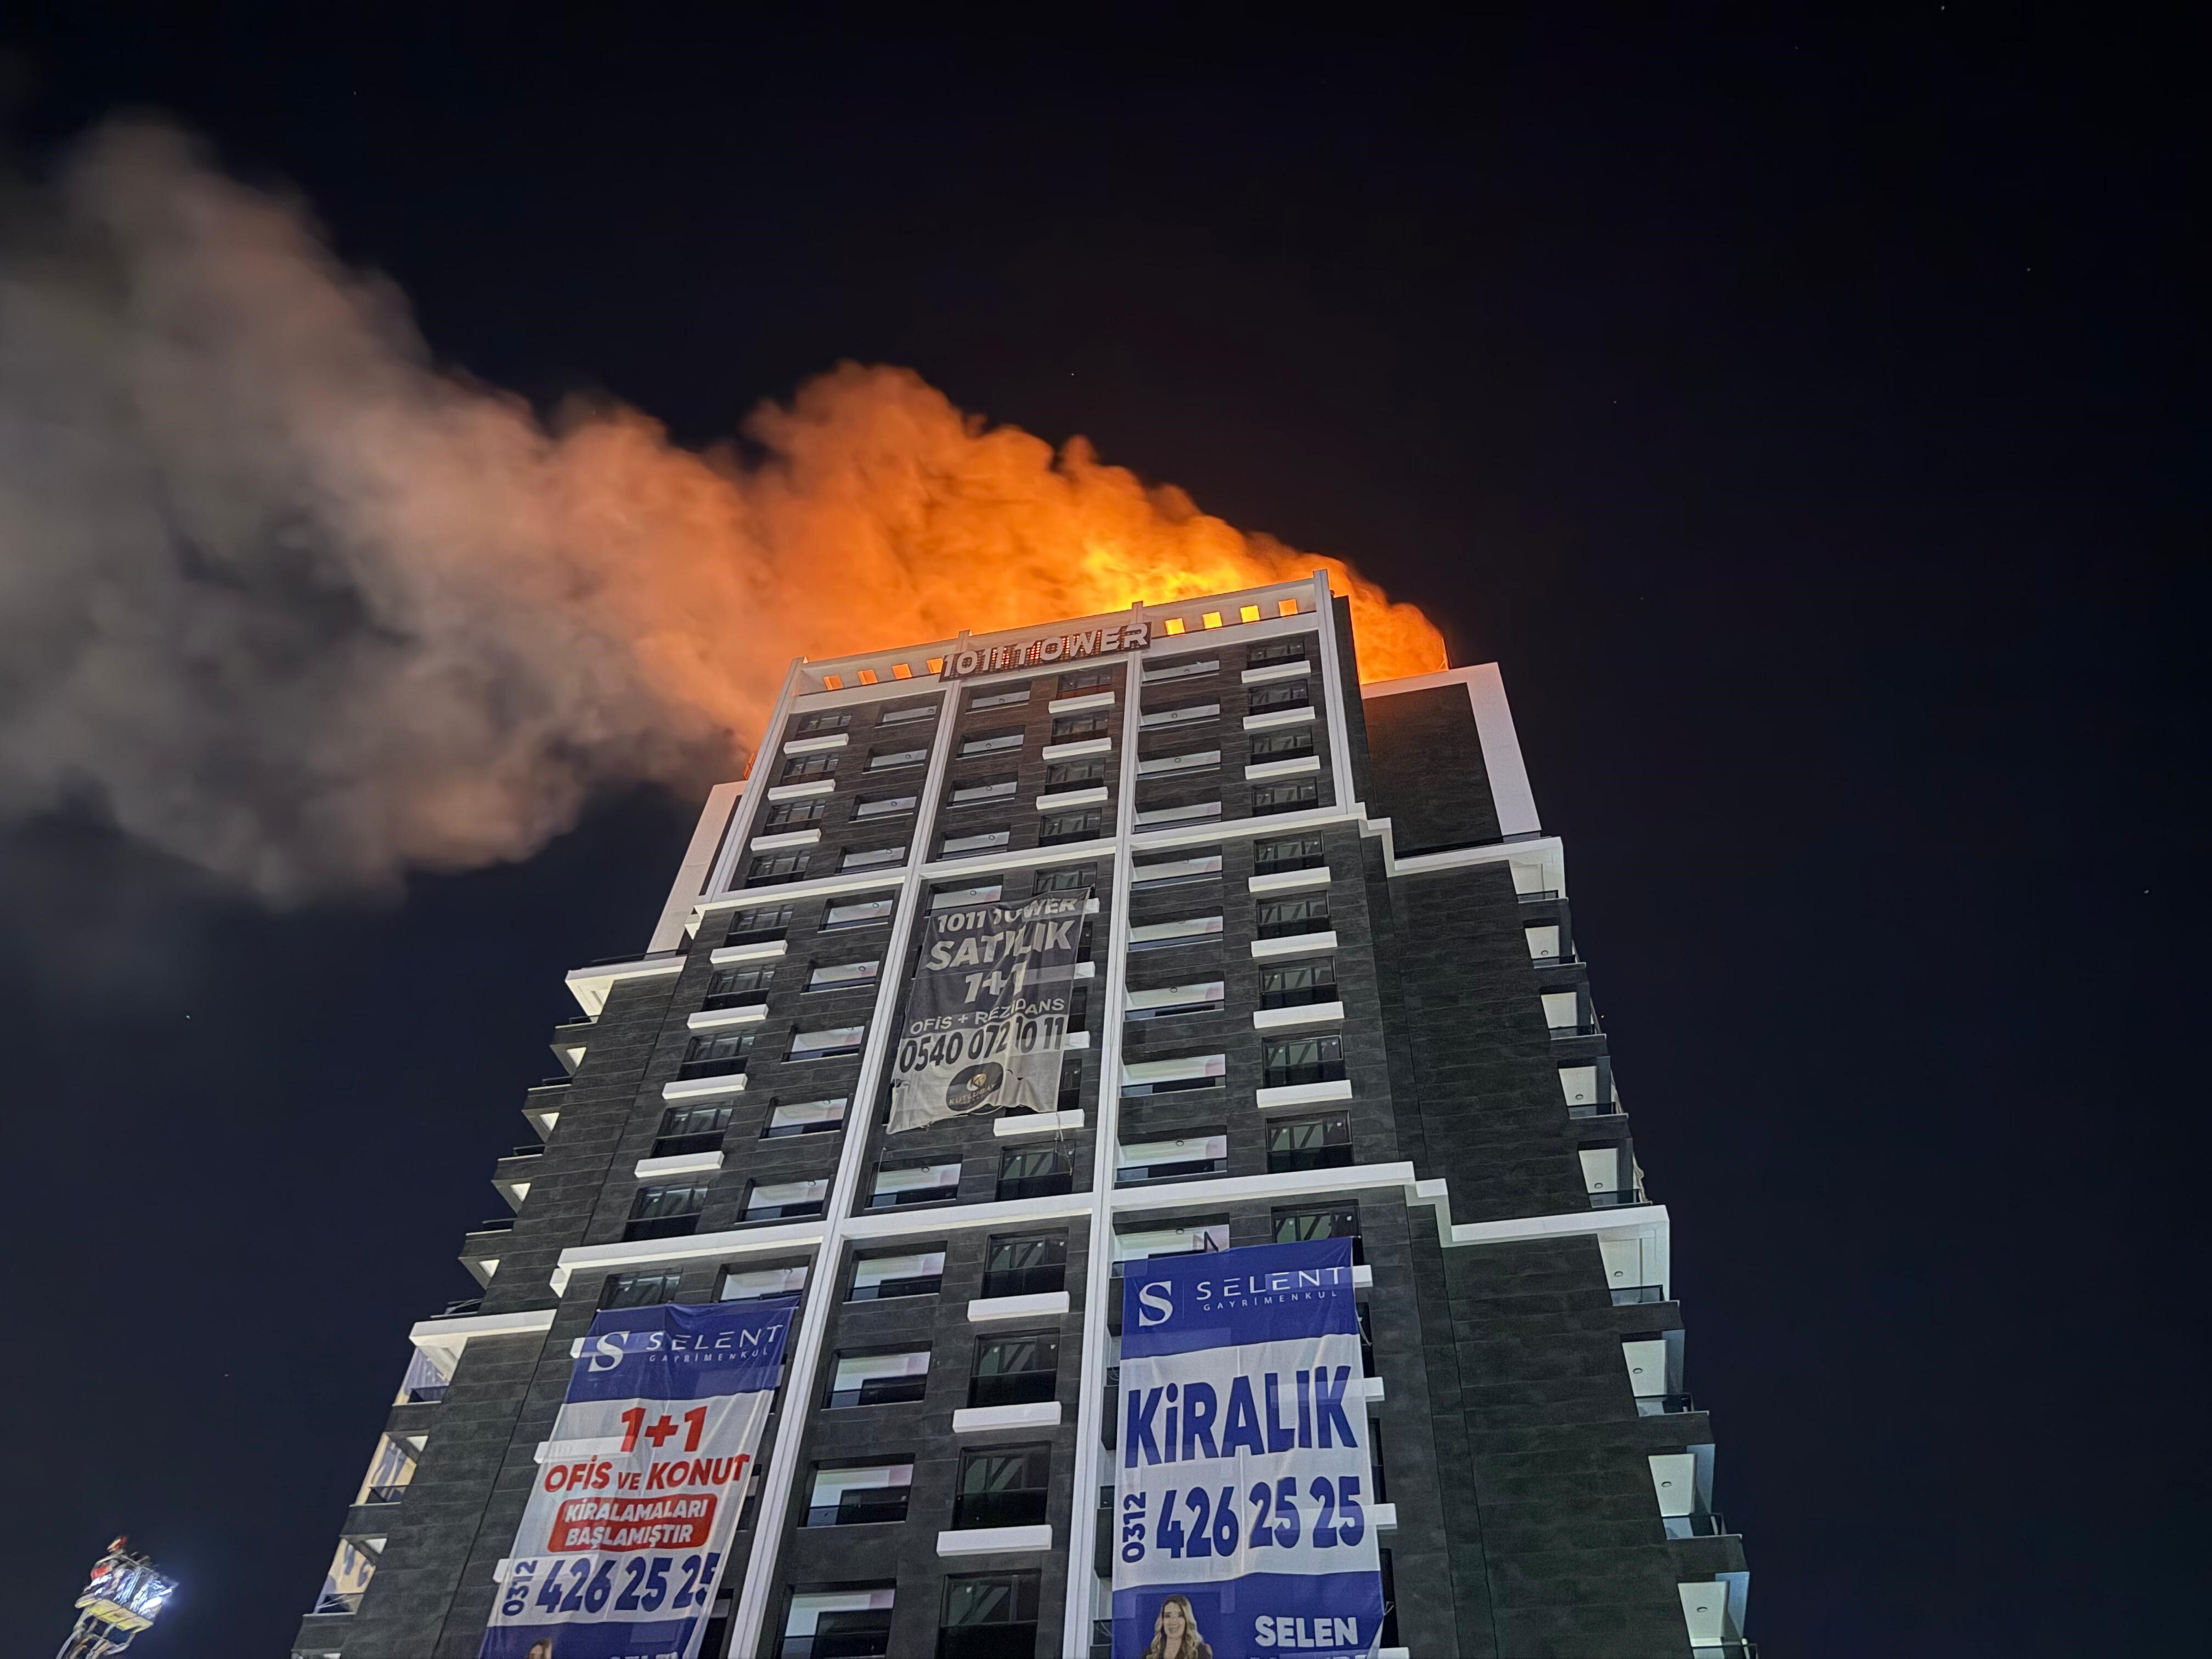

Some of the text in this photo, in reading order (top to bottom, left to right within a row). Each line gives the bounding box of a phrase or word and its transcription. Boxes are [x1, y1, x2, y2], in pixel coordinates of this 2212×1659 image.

[943, 623, 1148, 677] 1011 TOWER
[938, 910, 986, 933] 1011
[964, 961, 1028, 1004] 1+1
[957, 1014, 969, 1025] +
[899, 1031, 963, 1073] 0540
[1043, 1017, 1064, 1050] 11
[1139, 1280, 1173, 1327] S
[1197, 1266, 1345, 1301] SELENT
[588, 1330, 630, 1372] S
[646, 1324, 783, 1351] SELENT
[620, 1406, 708, 1453] 1+1
[618, 1472, 642, 1491] VE
[645, 1454, 751, 1490] KONUT
[564, 1524, 693, 1549] BAŞLAMIŞTIR
[1122, 1476, 1365, 1563] 0312 426 25 25
[534, 1557, 618, 1613] 426
[614, 1556, 673, 1612] 25
[1255, 1615, 1358, 1647] SELEN
